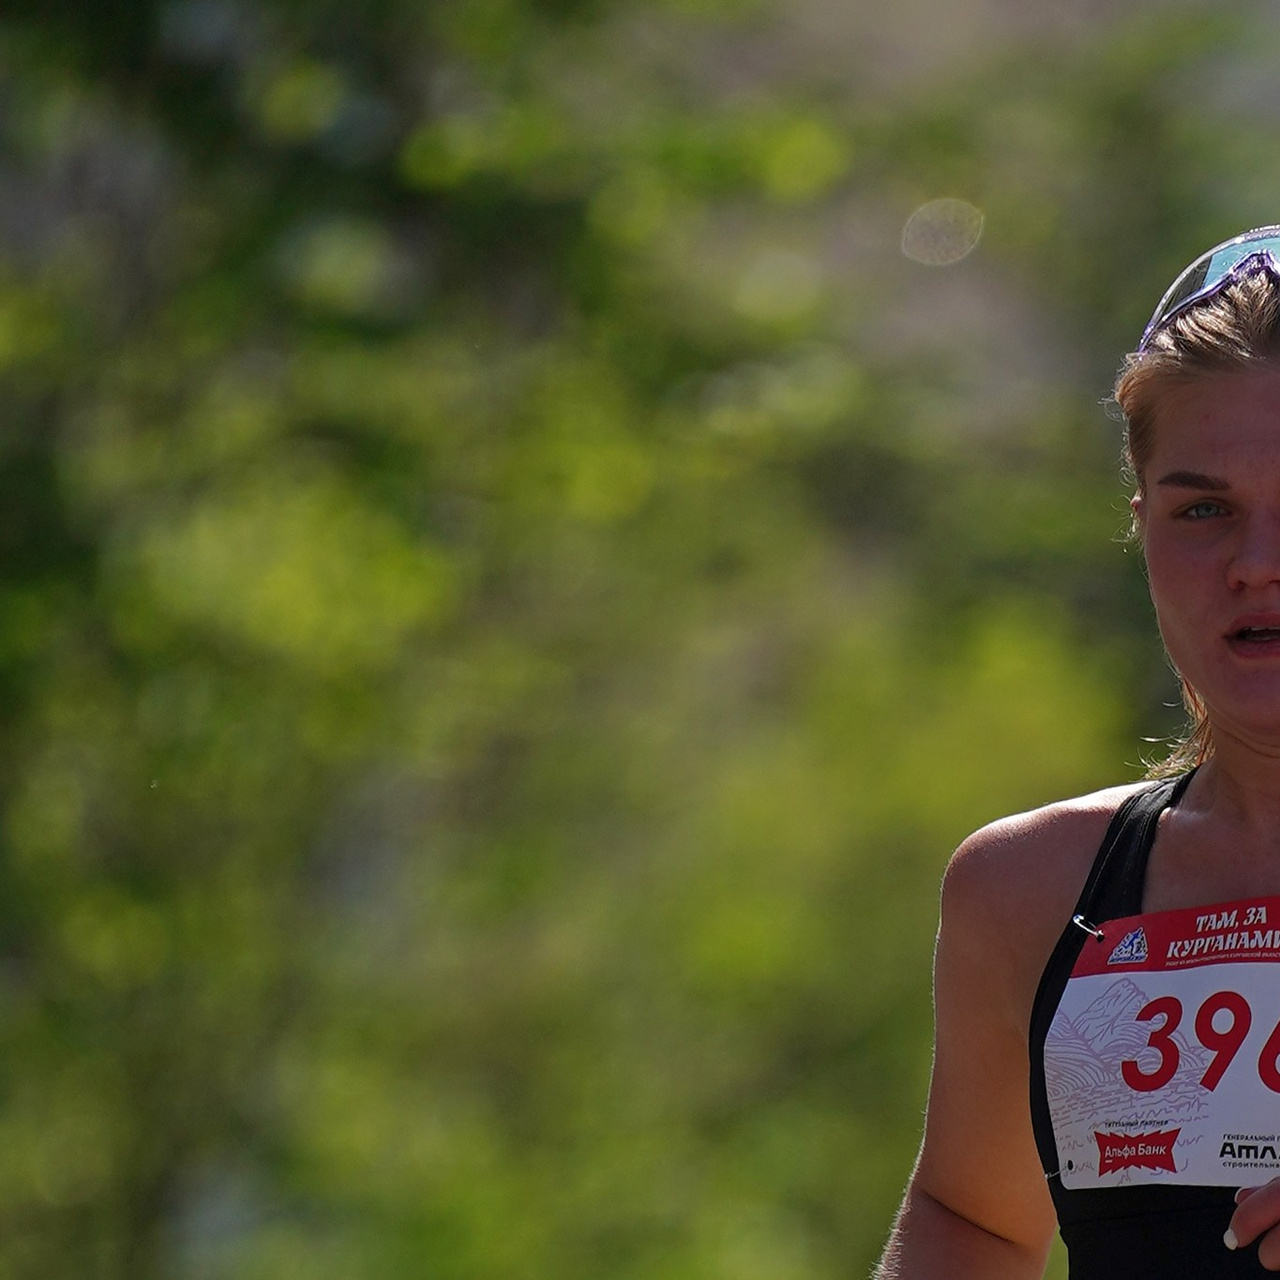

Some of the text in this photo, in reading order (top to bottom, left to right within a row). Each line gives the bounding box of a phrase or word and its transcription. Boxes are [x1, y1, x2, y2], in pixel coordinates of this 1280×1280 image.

[1196, 906, 1267, 933] ТАМ, ЗА
[1223, 1133, 1275, 1141] ГЕНЕРАЛЬНЫЙ
[1105, 1143, 1166, 1160] Альфа Банк
